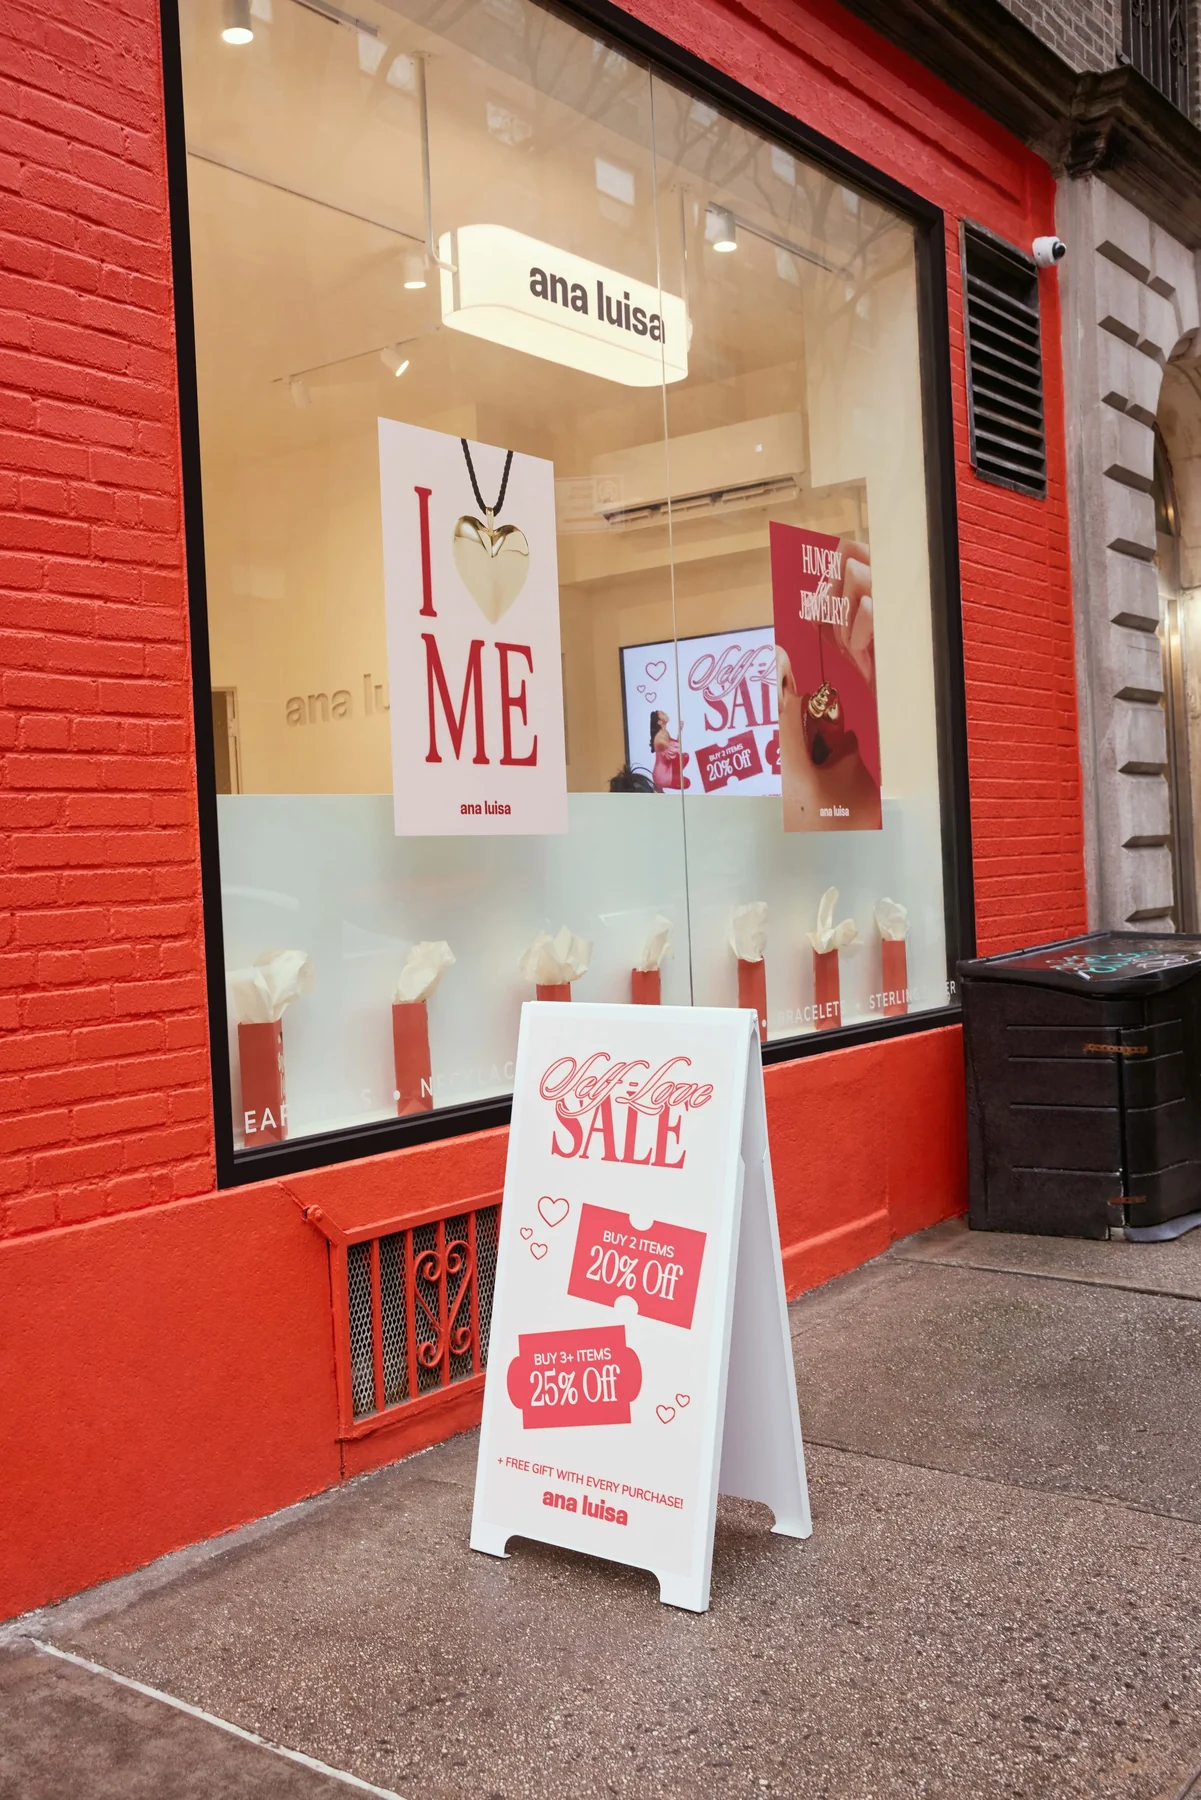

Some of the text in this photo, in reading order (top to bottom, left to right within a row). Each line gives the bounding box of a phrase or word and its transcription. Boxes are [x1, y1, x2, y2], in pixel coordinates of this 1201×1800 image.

[529, 267, 666, 344] ana luisa
[413, 485, 438, 618] I
[801, 543, 842, 580] HUNGRY
[799, 589, 850, 627] JEWELRY?
[285, 689, 353, 727] ana
[421, 632, 538, 767] ME
[702, 670, 779, 732] SAL
[706, 758, 733, 781] 20%
[733, 748, 752, 770] Off
[709, 752, 722, 762] BUY
[726, 743, 744, 755] ITEMS
[459, 799, 512, 816] ana luisa
[819, 804, 850, 817] ana luisa
[539, 1052, 714, 1118] Self-Love
[551, 1089, 689, 1169] SALE
[602, 1230, 675, 1259] BUY 2 ITEMS
[585, 1245, 684, 1301] 20% Off
[533, 1347, 612, 1366] BUY 3+ ITEMS
[529, 1364, 621, 1407] 25% Off
[505, 1456, 530, 1472] FREE
[532, 1463, 554, 1477] GIFT
[556, 1468, 584, 1485] WITH
[586, 1476, 620, 1493] EVERY
[621, 1484, 684, 1510] PURCHASE!
[542, 1489, 629, 1526] ana luisa
